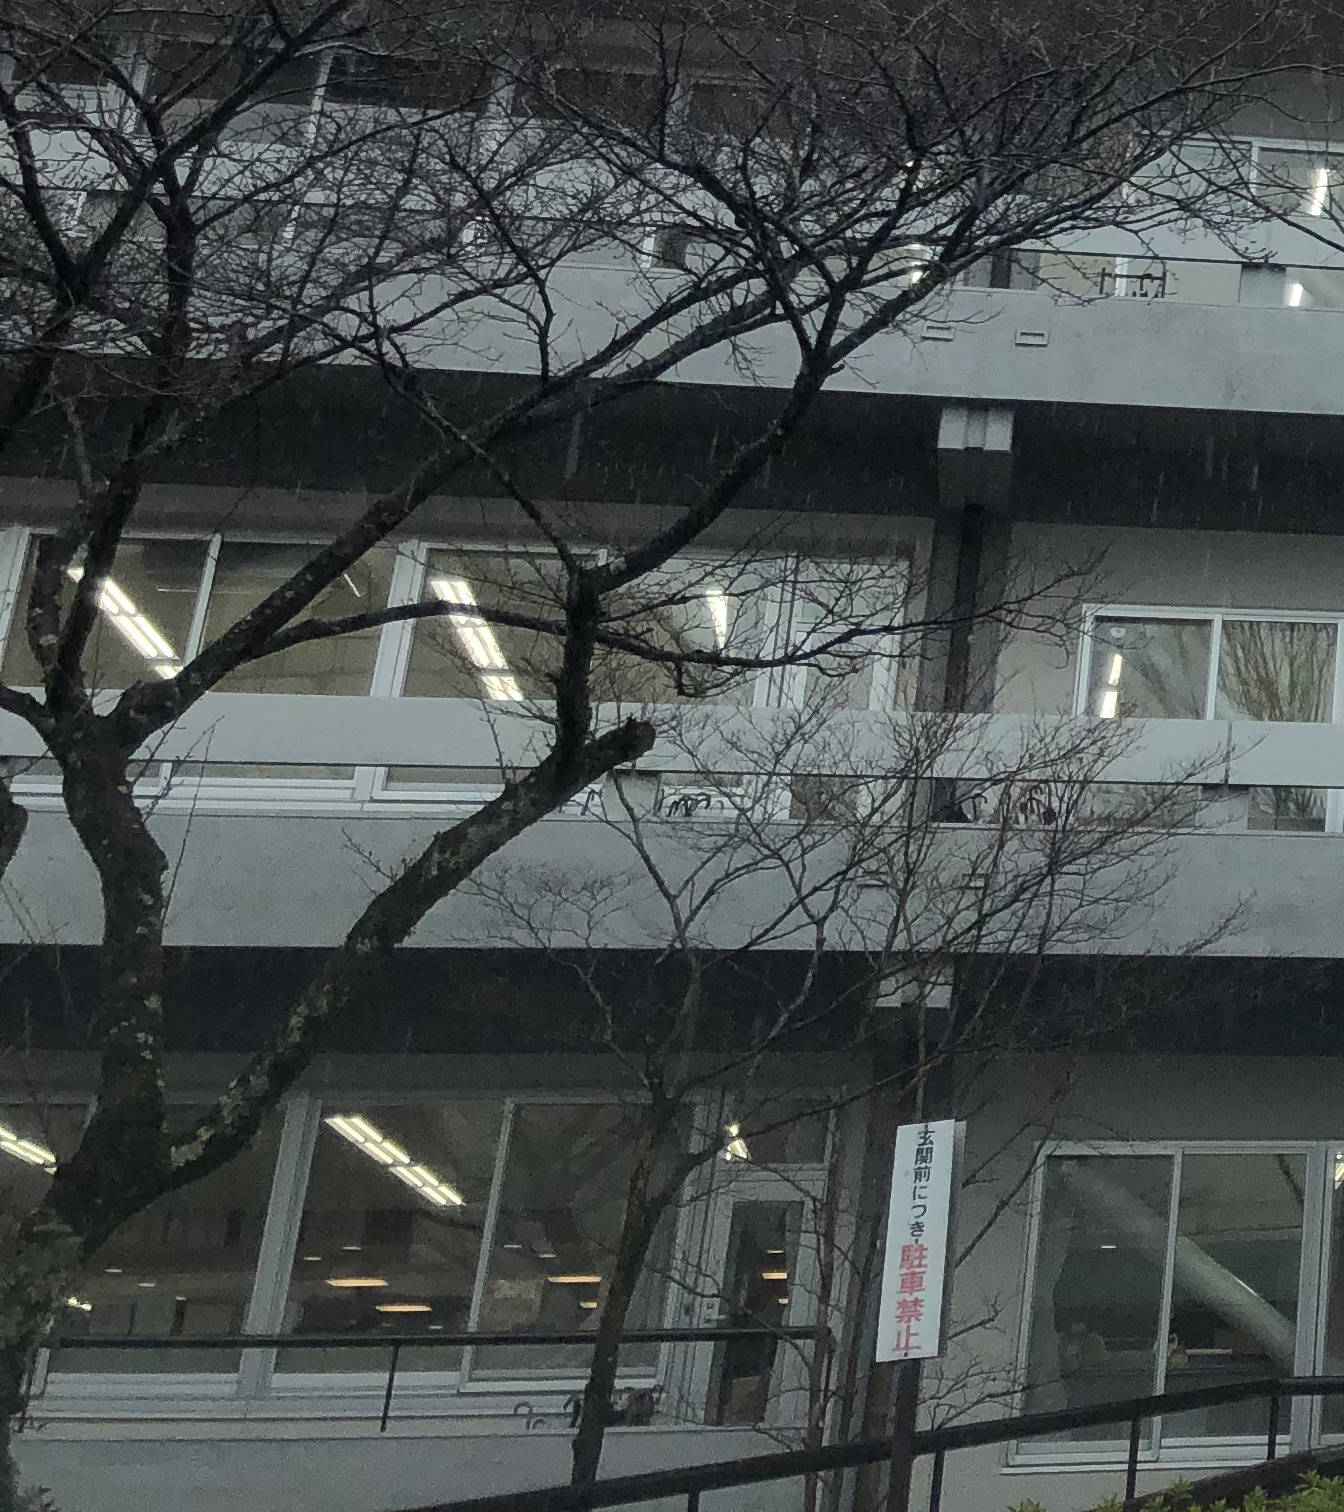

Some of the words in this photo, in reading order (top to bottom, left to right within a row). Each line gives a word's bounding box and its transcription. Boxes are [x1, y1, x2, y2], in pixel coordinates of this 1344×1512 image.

[910, 1124, 935, 1237] 玄関前につき
[892, 1243, 928, 1352] 駐車禁止
